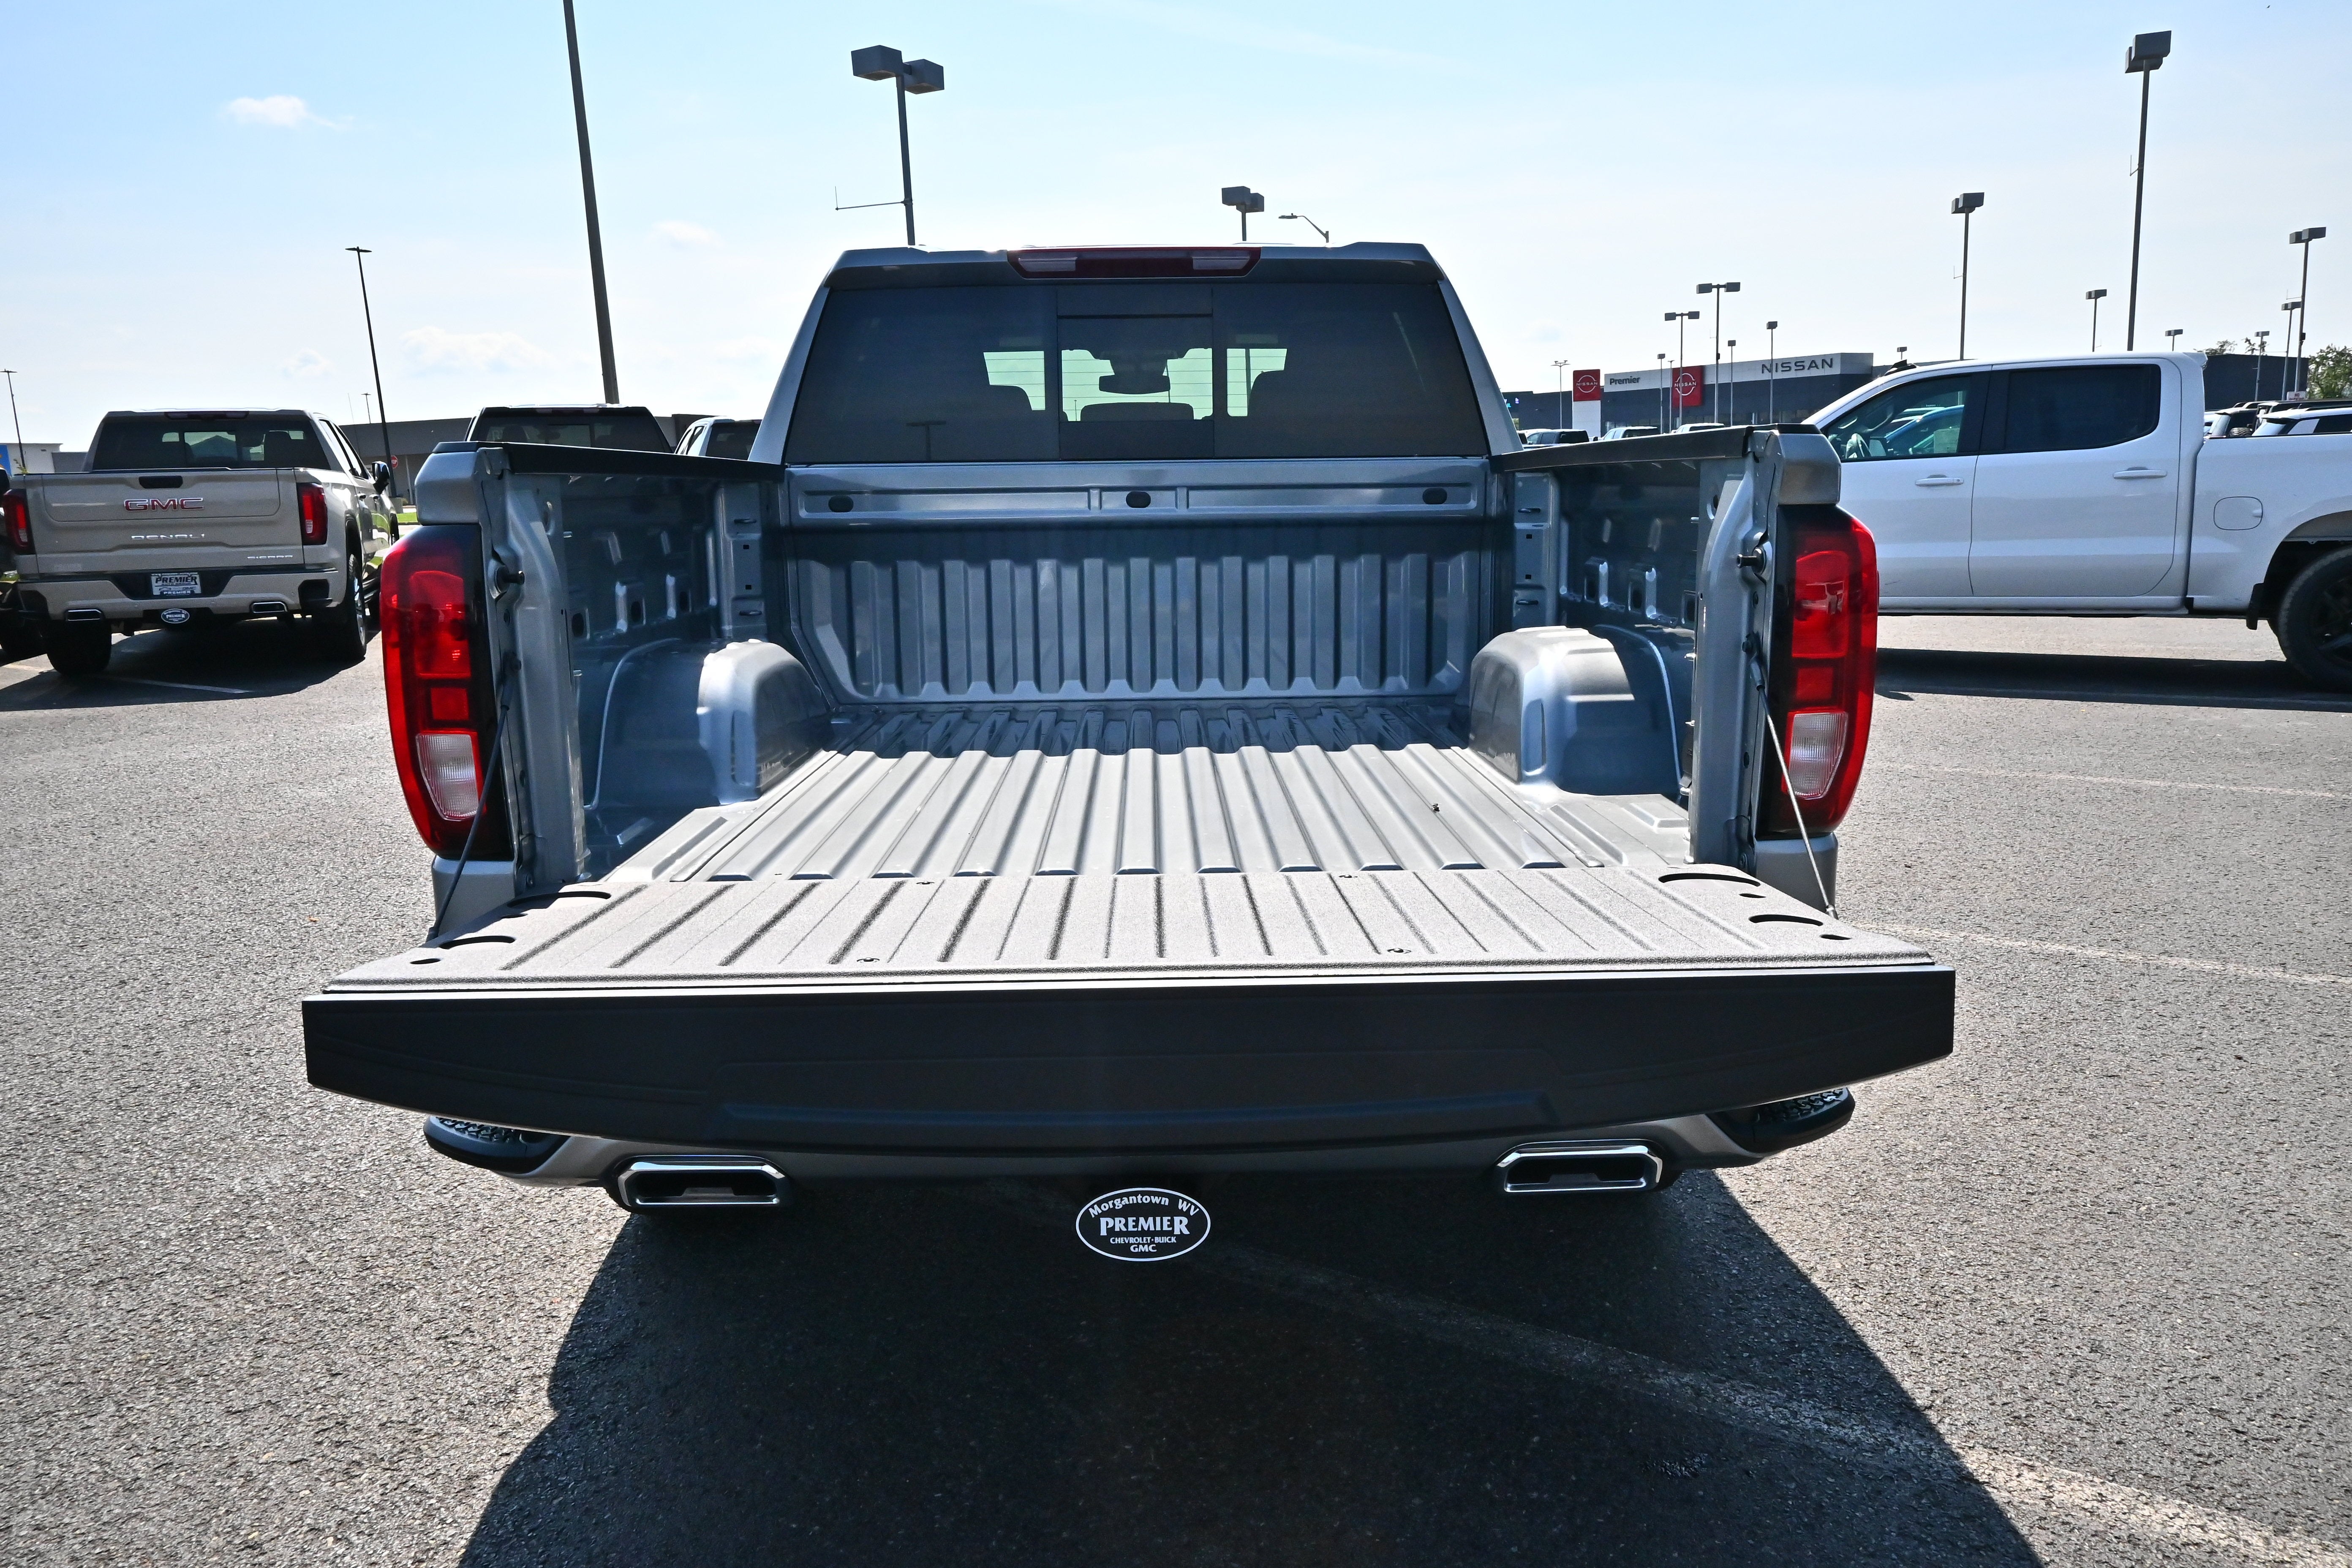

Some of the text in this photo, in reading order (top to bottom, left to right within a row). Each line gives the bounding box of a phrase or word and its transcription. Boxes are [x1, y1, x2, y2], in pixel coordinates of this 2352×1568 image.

[1761, 358, 1833, 373] NISSAN
[1610, 376, 1640, 385] Premier
[124, 498, 204, 512] GMC
[155, 576, 198, 585] PREMIER
[1088, 1194, 1200, 1218] Morgantown WV
[1100, 1216, 1190, 1236] PREMIER
[1130, 1244, 1157, 1252] GMC
